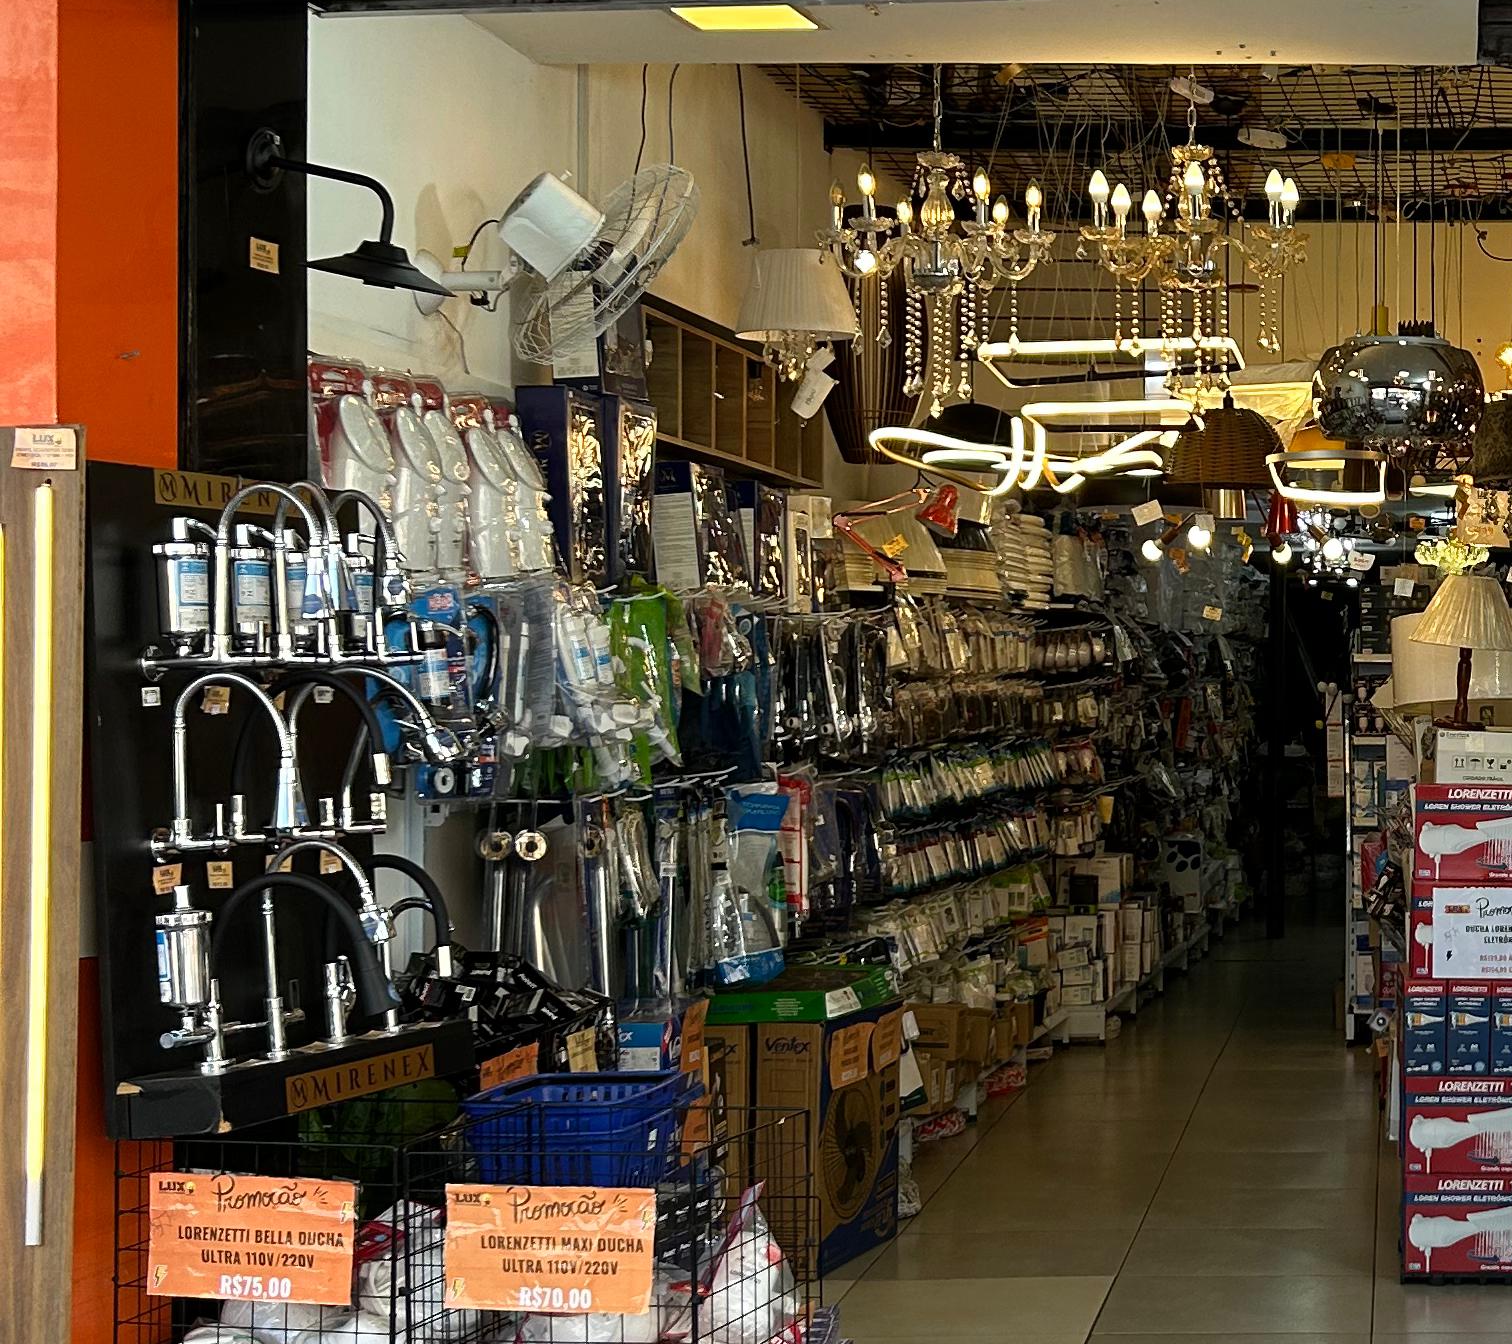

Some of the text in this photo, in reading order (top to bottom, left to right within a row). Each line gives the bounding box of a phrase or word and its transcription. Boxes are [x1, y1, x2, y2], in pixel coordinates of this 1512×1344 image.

[1448, 788, 1512, 800] LORENZETTI
[1407, 985, 1443, 993] LORENZETTI
[1452, 985, 1488, 993] LORENZETTI
[765, 1036, 811, 1055] Ventex
[310, 1046, 432, 1100] MIRENEX
[1438, 1080, 1504, 1093] LORENZETTI
[159, 1173, 308, 1213] LUX Promoção
[1438, 1179, 1504, 1191] LORENZETTI
[455, 1186, 606, 1225] LUX Promoção
[178, 1225, 345, 1248] LORENZETTI BELLA DUCHA
[481, 1235, 644, 1253] LORENZETTI MAXI DUCHA
[201, 1248, 315, 1269] ULTRA 110V/220V
[502, 1258, 619, 1276] ULTRA 110V/220V
[219, 1274, 292, 1298] R$75,00
[518, 1285, 593, 1311] R$70,00
